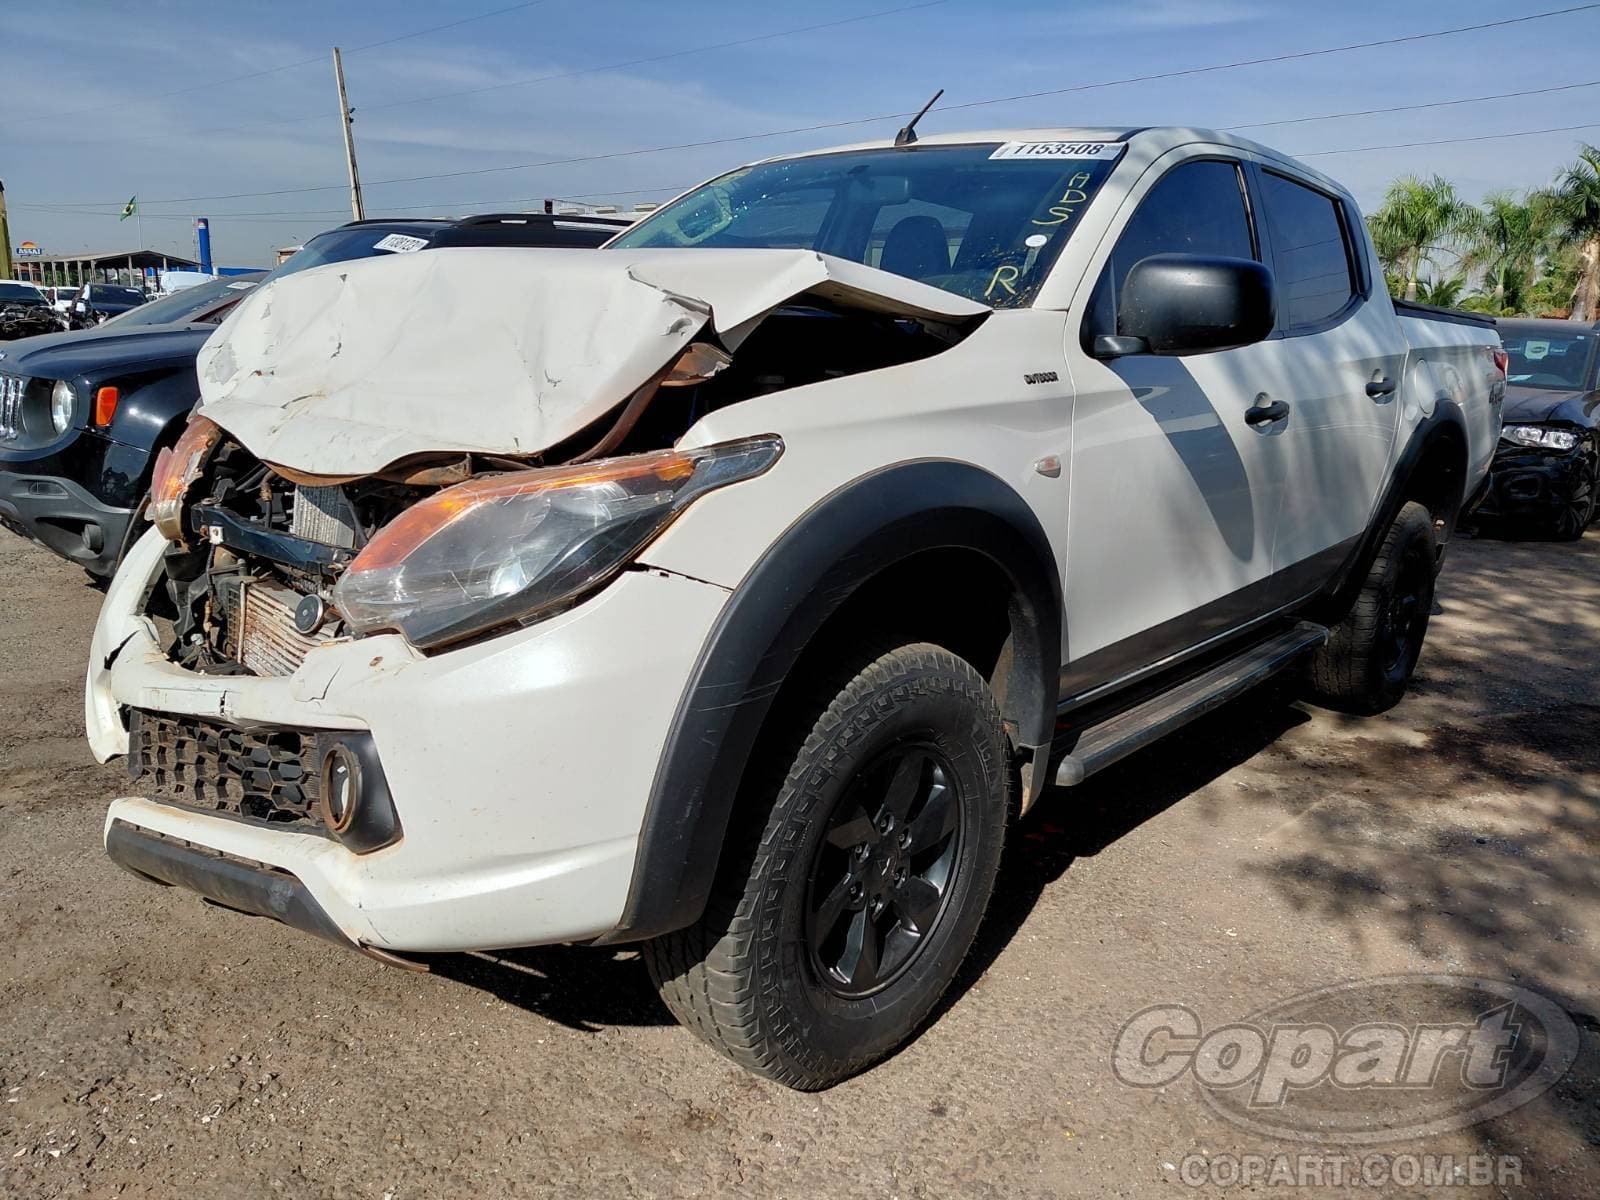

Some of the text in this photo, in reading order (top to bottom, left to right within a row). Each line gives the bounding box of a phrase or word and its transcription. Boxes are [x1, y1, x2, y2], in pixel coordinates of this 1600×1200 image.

[1013, 144, 1105, 155] 1153508
[984, 265, 1019, 296] R
[1024, 371, 1059, 384] OUTDOOR
